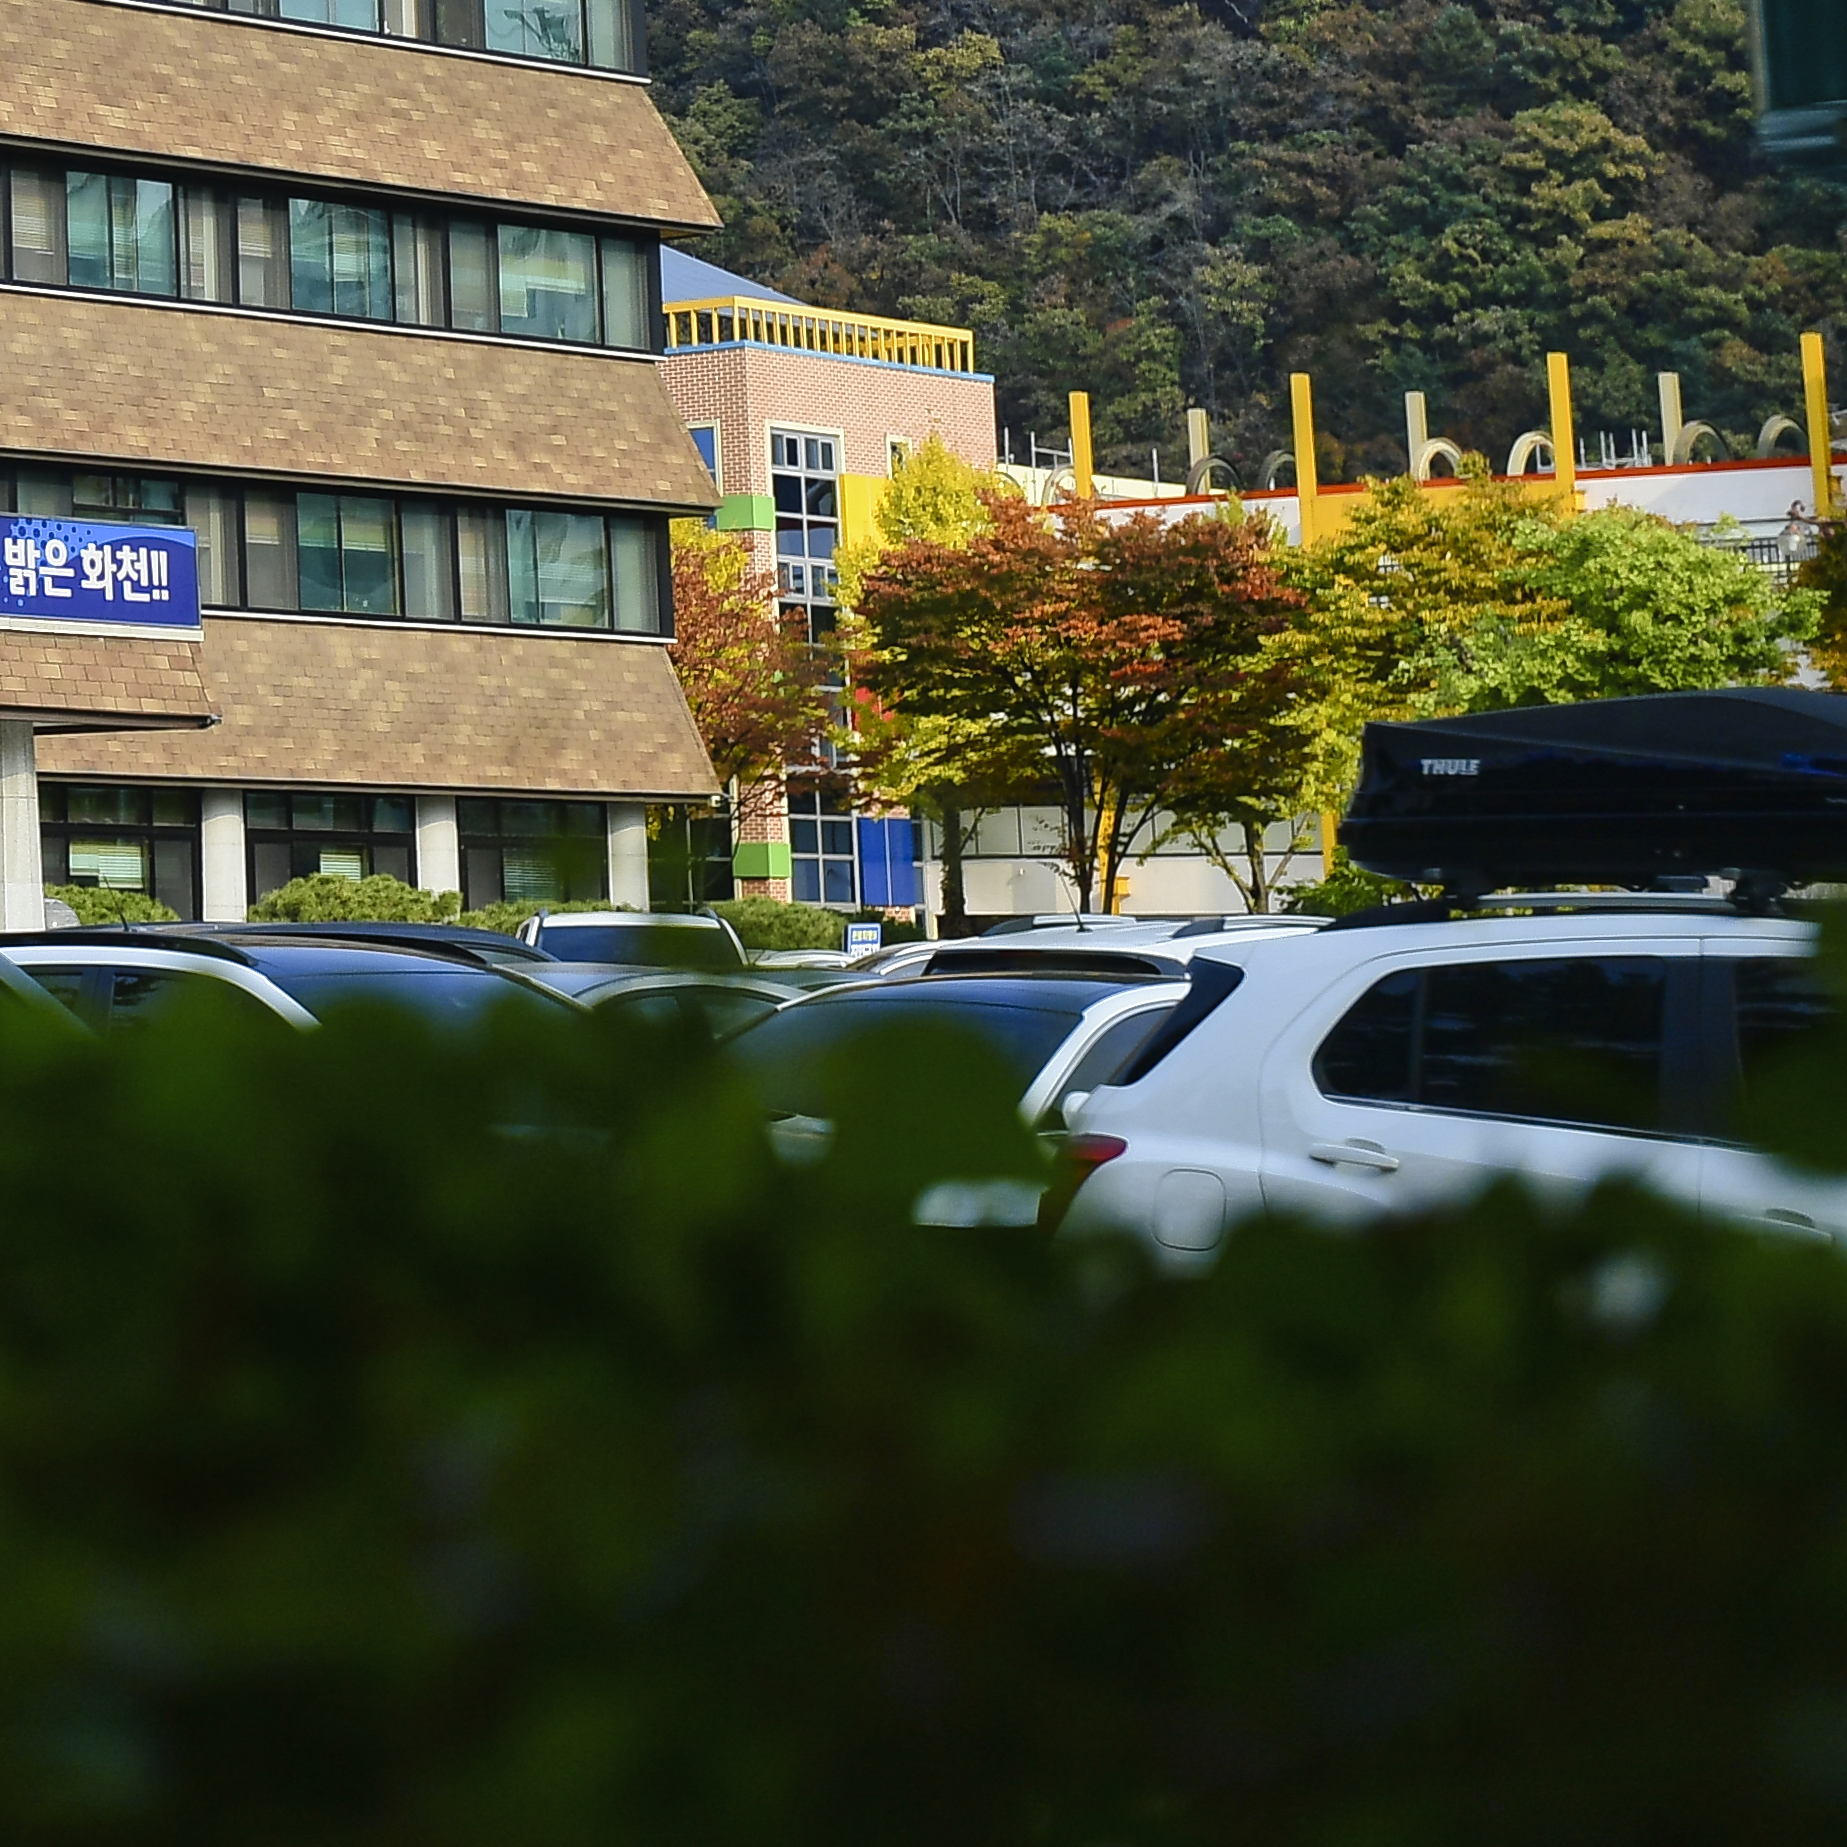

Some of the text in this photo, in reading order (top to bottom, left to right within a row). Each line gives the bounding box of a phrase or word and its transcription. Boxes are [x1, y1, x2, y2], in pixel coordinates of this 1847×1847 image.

[4, 537, 75, 598] 밝은
[80, 543, 171, 602] 화천!!
[1420, 759, 1480, 775] THULE
